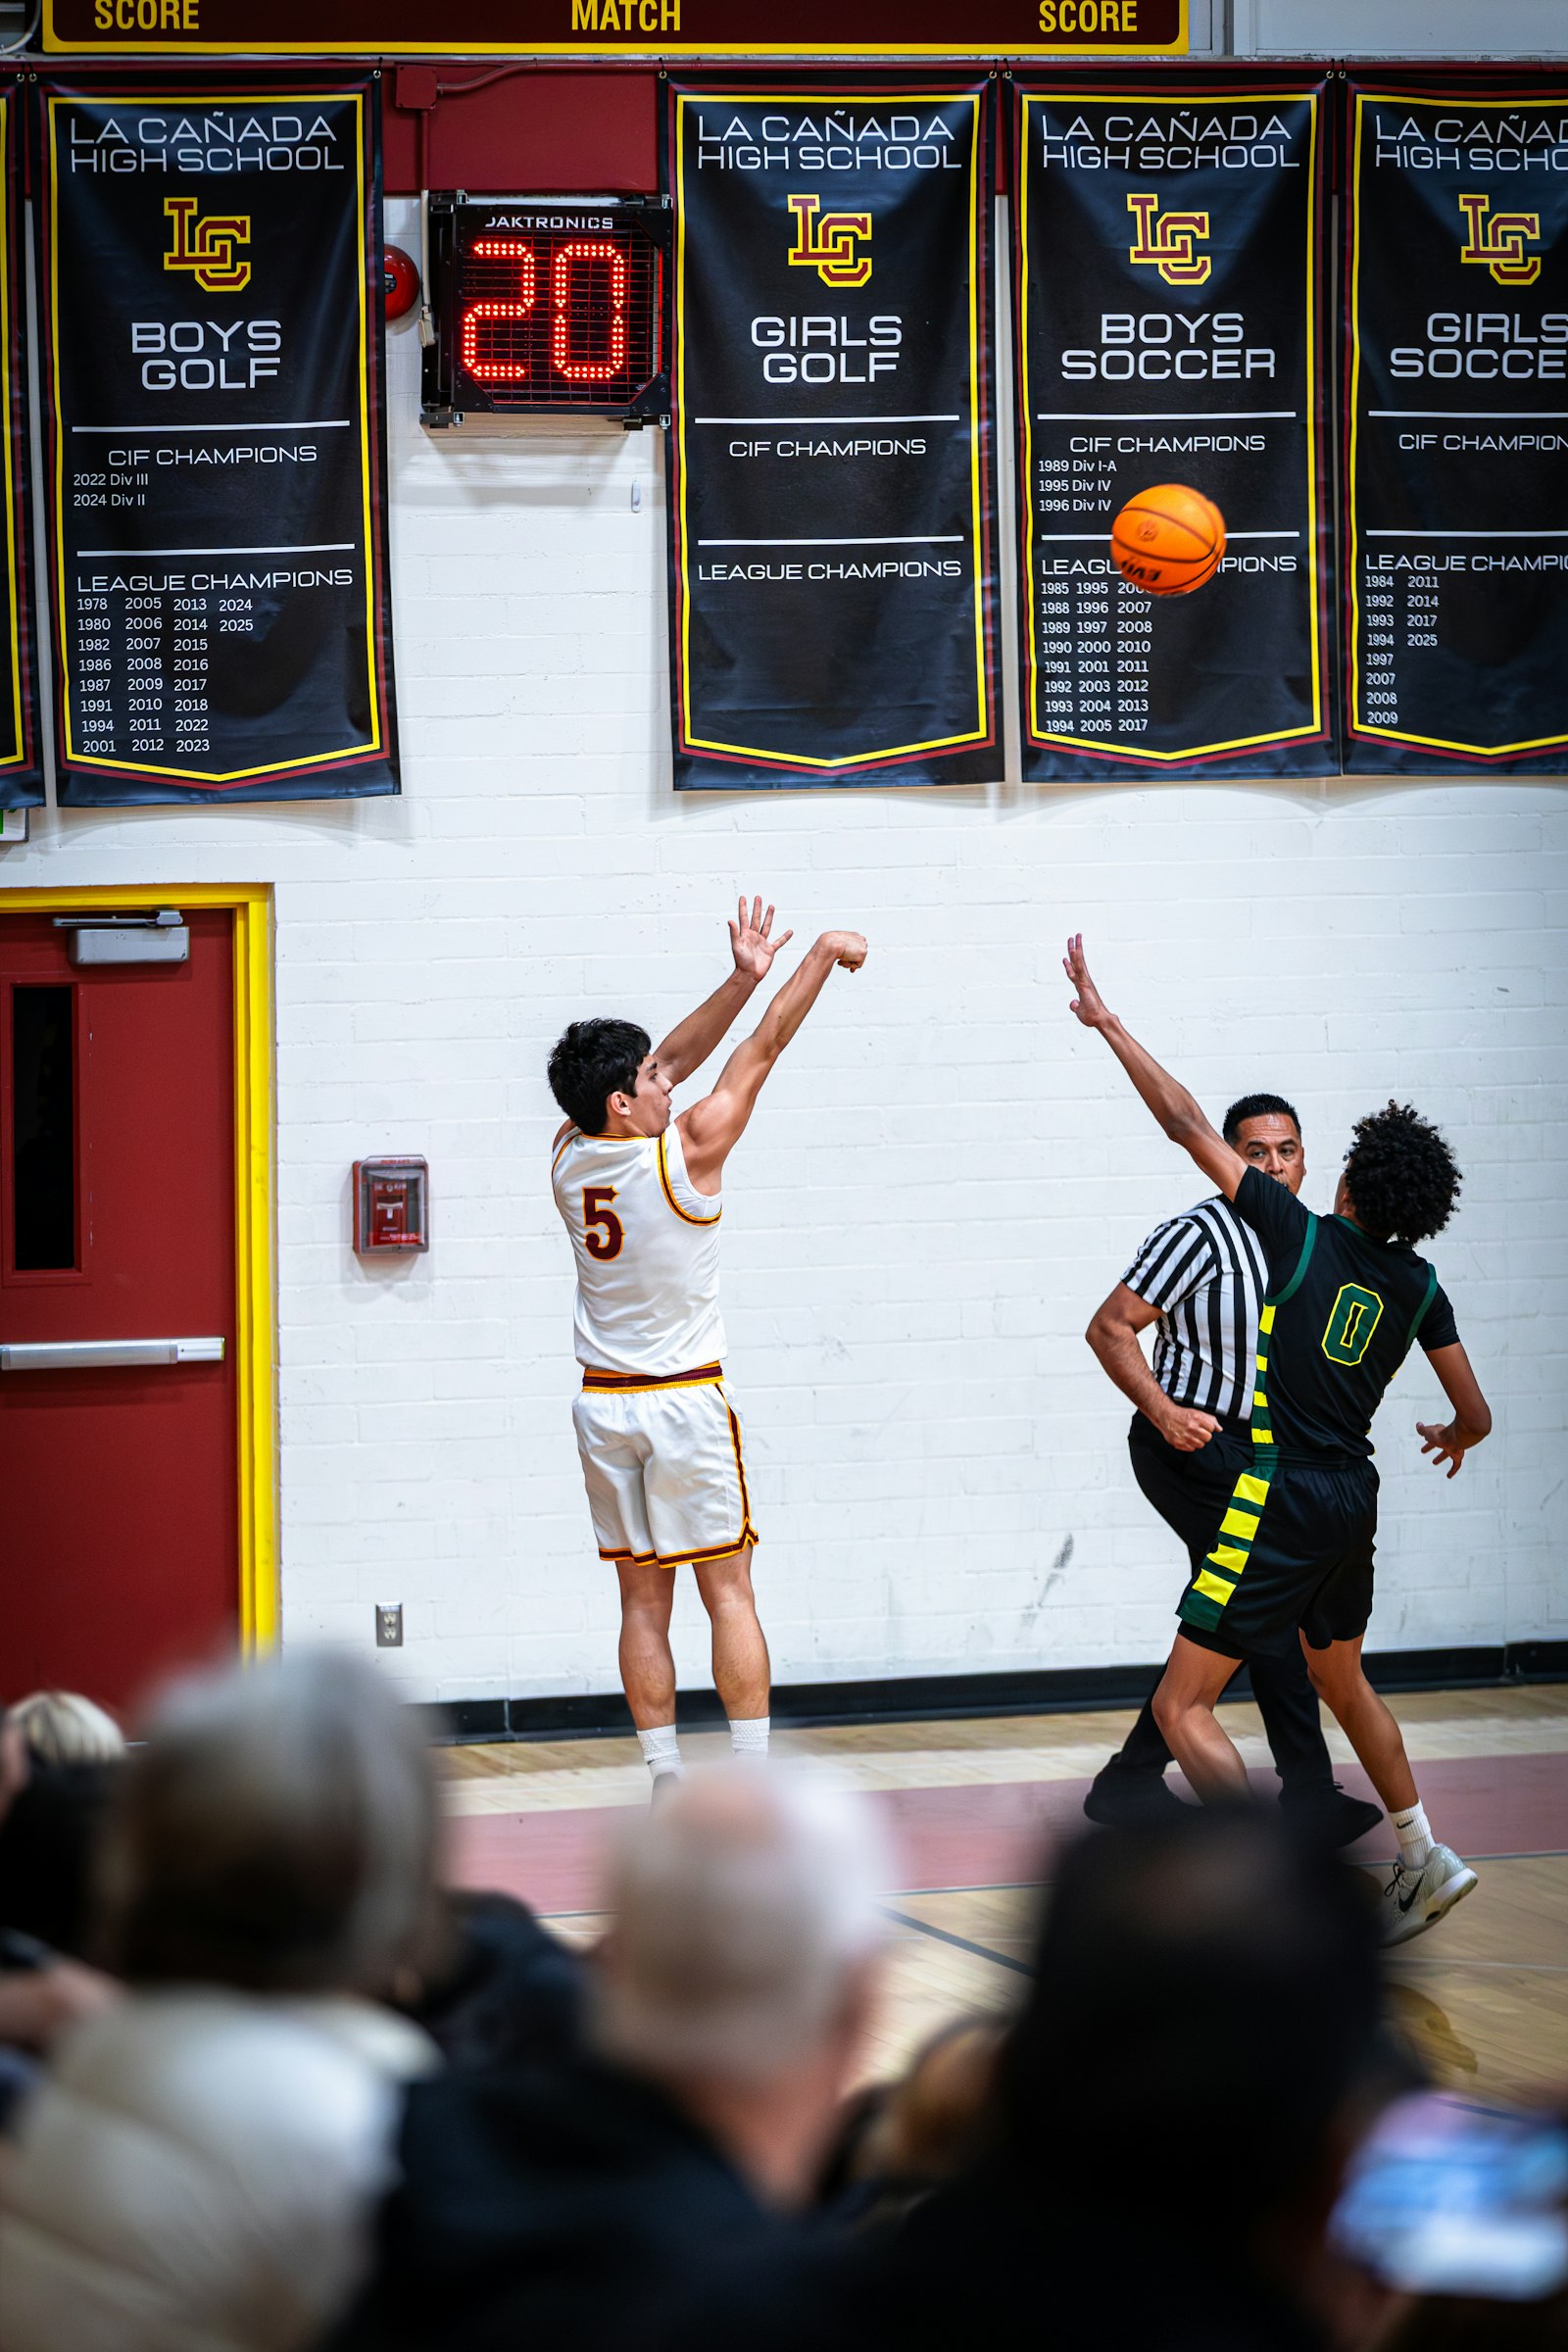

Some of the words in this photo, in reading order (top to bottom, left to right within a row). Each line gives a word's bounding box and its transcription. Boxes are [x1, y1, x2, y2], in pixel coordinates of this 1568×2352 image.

[95, 0, 200, 29] SCORE
[571, 0, 681, 31] MATCH
[1039, 0, 1138, 32] SCORE
[72, 118, 128, 143] LA
[138, 112, 336, 143] CAÑADA
[700, 116, 753, 141] LA
[762, 111, 955, 141] CAÑADA
[1043, 116, 1095, 141] LA
[1105, 112, 1292, 141] CAÑADA
[1376, 116, 1425, 141] LA
[72, 148, 167, 172] HIGH
[177, 147, 344, 172] SCHOOL
[699, 146, 789, 170] HIGH
[800, 146, 960, 170] SCHOOL
[1044, 145, 1129, 169] HIGH
[1140, 145, 1299, 169] SCHOOL
[1376, 145, 1459, 170] HIGH
[464, 242, 625, 378] 20
[752, 317, 902, 346] GIRLS
[1102, 314, 1243, 343] BOYS
[1427, 313, 1568, 342] GIRLS
[132, 320, 281, 353] BOYS
[763, 352, 899, 383] GOLF
[1061, 349, 1275, 379] SOCCER
[142, 358, 280, 390] GOLF
[730, 442, 771, 457] CIF
[777, 439, 926, 457] CHAMPIONS
[1070, 437, 1111, 452] CIF
[1118, 436, 1265, 452] CHAMPIONS
[1399, 434, 1438, 449] CIF
[109, 450, 150, 466] CIF
[157, 446, 317, 465] CHAMPIONS
[1039, 461, 1069, 471] 1989
[1073, 460, 1095, 471] Div
[1099, 461, 1116, 471] I-A
[74, 474, 106, 485] 2022
[111, 473, 132, 485] Div
[137, 473, 148, 485] III
[1040, 480, 1069, 491] 1995
[1073, 479, 1094, 491] Div
[1098, 480, 1110, 491] IV
[74, 494, 107, 506] 2024
[112, 494, 133, 506] Div
[138, 494, 144, 505] II
[1040, 500, 1069, 511] 1996
[1073, 499, 1095, 511] Div
[1099, 500, 1111, 511] IV
[1042, 560, 1121, 575] LEAGU
[1217, 556, 1297, 572] PIONS
[1366, 555, 1466, 570] LEAGUE
[1472, 556, 1568, 570] CHAMPI
[699, 564, 803, 580] LEAGUE
[808, 561, 961, 579] CHAMPIONS
[78, 575, 185, 592] LEAGUE
[192, 569, 352, 590] CHAMPIONS
[1366, 575, 1394, 587] 1984
[1408, 576, 1439, 588] 2011
[1042, 582, 1069, 594] 1985
[1077, 582, 1108, 594] 1995
[1117, 582, 1152, 594] 200
[77, 598, 107, 610] 1978
[125, 598, 162, 609] 2005
[174, 599, 207, 611] 2013
[220, 599, 253, 611] 2024
[1042, 602, 1069, 613] 1988
[1077, 602, 1108, 613] 1996
[1117, 602, 1152, 613] 2007
[1366, 595, 1394, 607] 1992
[1407, 595, 1439, 607] 2014
[78, 618, 111, 630] 1980
[125, 617, 162, 629] 2006
[174, 618, 208, 630] 2014
[220, 619, 253, 631] 2025
[1043, 622, 1070, 633] 1989
[1077, 621, 1106, 633] 1997
[1117, 621, 1152, 633] 2008
[1367, 614, 1394, 626] 1993
[1407, 614, 1437, 626] 2017
[78, 639, 110, 651] 1982
[126, 638, 160, 650] 2007
[174, 639, 208, 651] 2015
[1044, 642, 1072, 653] 1990
[1077, 641, 1110, 653] 2000
[1117, 641, 1151, 653] 2010
[1367, 634, 1395, 646] 1994
[1407, 634, 1437, 646] 2025
[79, 659, 111, 671] 1986
[127, 658, 162, 670] 2008
[174, 659, 208, 670] 2016
[1366, 654, 1394, 665] 1997
[1045, 662, 1071, 673] 1991
[1078, 661, 1109, 672] 2001
[1117, 661, 1149, 672] 2011
[80, 679, 110, 691] 1987
[128, 678, 163, 690] 2009
[174, 679, 207, 691] 2017
[1366, 672, 1396, 685] 2007
[1045, 681, 1072, 693] 1992
[1079, 680, 1110, 692] 2003
[1117, 680, 1149, 692] 2012
[81, 700, 112, 711] 1991
[129, 698, 162, 710] 2010
[175, 699, 208, 711] 2018
[1367, 692, 1397, 705] 2008
[1046, 701, 1073, 712] 1993
[1080, 700, 1111, 711] 2004
[1118, 700, 1149, 711] 2013
[1367, 711, 1397, 723] 2009
[82, 720, 114, 732] 1994
[129, 718, 161, 731] 2011
[176, 719, 208, 731] 2022
[1047, 720, 1074, 732] 1994
[1080, 719, 1111, 731] 2005
[1118, 719, 1148, 731] 2017
[83, 740, 116, 753] 2001
[132, 739, 164, 751] 2012
[176, 739, 210, 752] 2023
[582, 1185, 625, 1261] 5
[1322, 1283, 1384, 1366] 0
